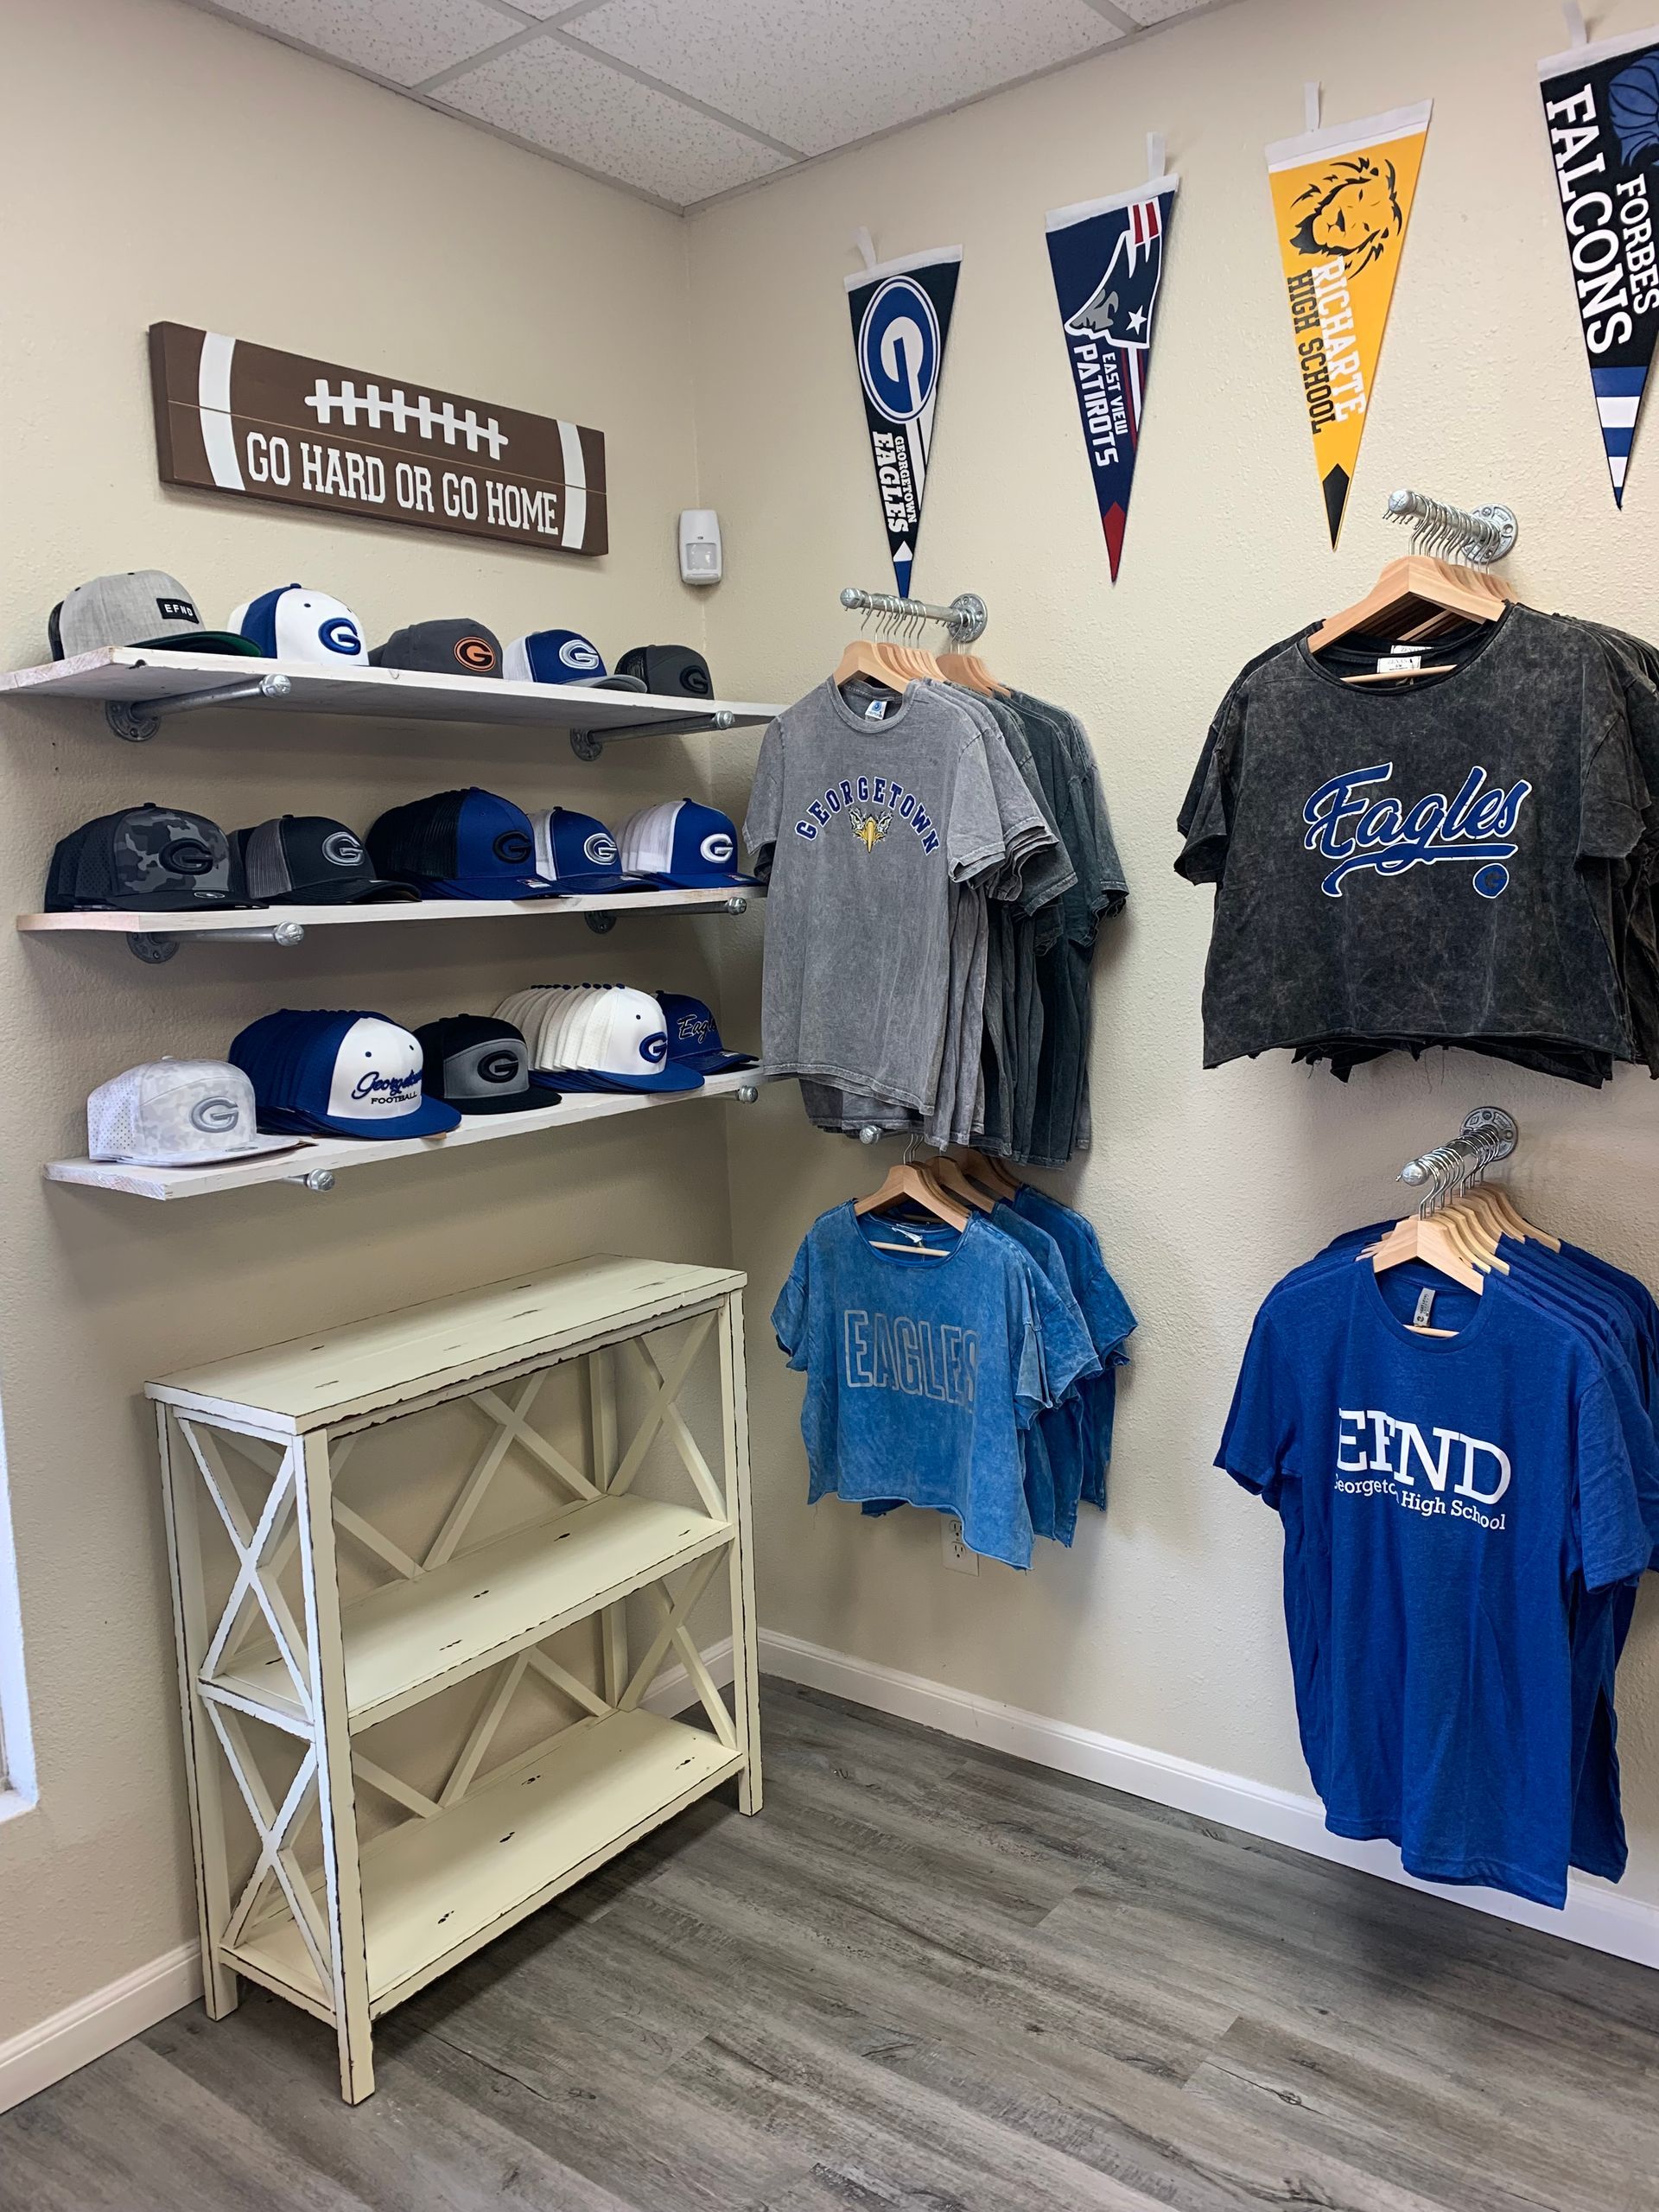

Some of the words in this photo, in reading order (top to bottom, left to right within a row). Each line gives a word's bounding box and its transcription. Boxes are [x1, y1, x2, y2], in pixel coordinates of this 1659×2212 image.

[1546, 83, 1632, 354] FALCONS
[1616, 173, 1659, 315] FORBES
[1287, 270, 1320, 334] HIGH
[1102, 352, 1122, 391] EAST
[1312, 256, 1367, 423] RICHARTE
[1073, 343, 1119, 467] PATIROTS
[1109, 395, 1129, 435] VIEW
[1299, 337, 1336, 435] SCHOOL
[247, 432, 290, 486] GO
[300, 442, 385, 504] HARD
[396, 462, 434, 512] OR
[442, 472, 478, 520] GO
[486, 481, 558, 535] HOME
[873, 430, 910, 533] EAGLES
[894, 435, 917, 524] GEORGETOWN
[164, 603, 194, 617] EFND
[319, 617, 361, 655] G
[559, 639, 600, 671] G
[322, 831, 364, 866] G
[701, 833, 733, 863] G
[794, 775, 940, 856] GEORGETOWN
[1303, 762, 1532, 897] Eagles
[189, 1096, 238, 1134] G
[371, 1091, 417, 1105] FOOTBALL
[1337, 1408, 1511, 1504] EFND
[1401, 1491, 1446, 1516] High
[1451, 1499, 1506, 1530] School
